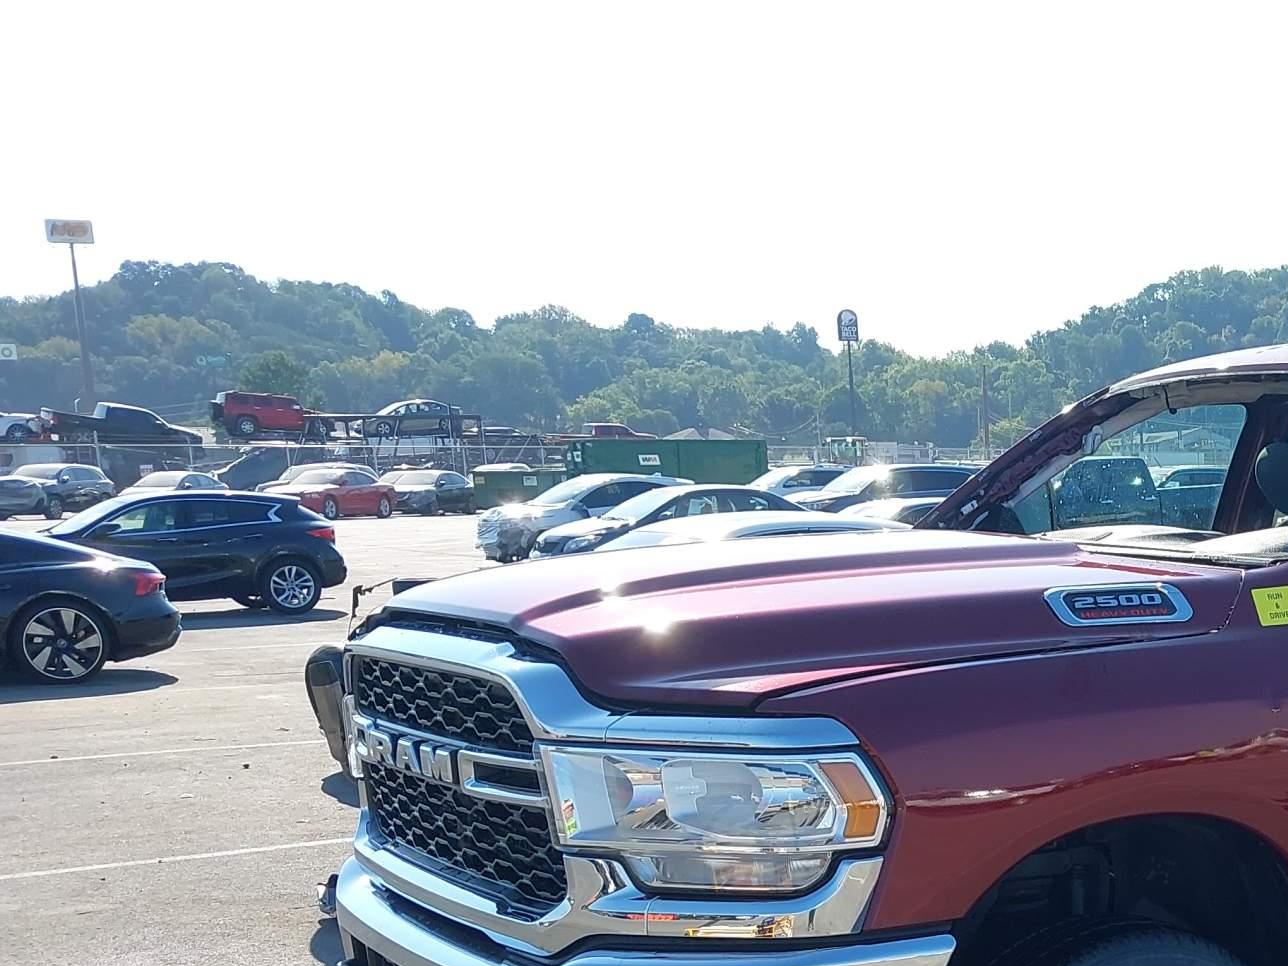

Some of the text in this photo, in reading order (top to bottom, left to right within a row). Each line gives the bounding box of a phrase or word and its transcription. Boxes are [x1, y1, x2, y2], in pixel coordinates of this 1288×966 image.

[1073, 593, 1162, 609] 2500
[1267, 592, 1283, 600] RUN
[1080, 608, 1168, 618] HEAVY DUTY
[367, 730, 453, 784] RAM
